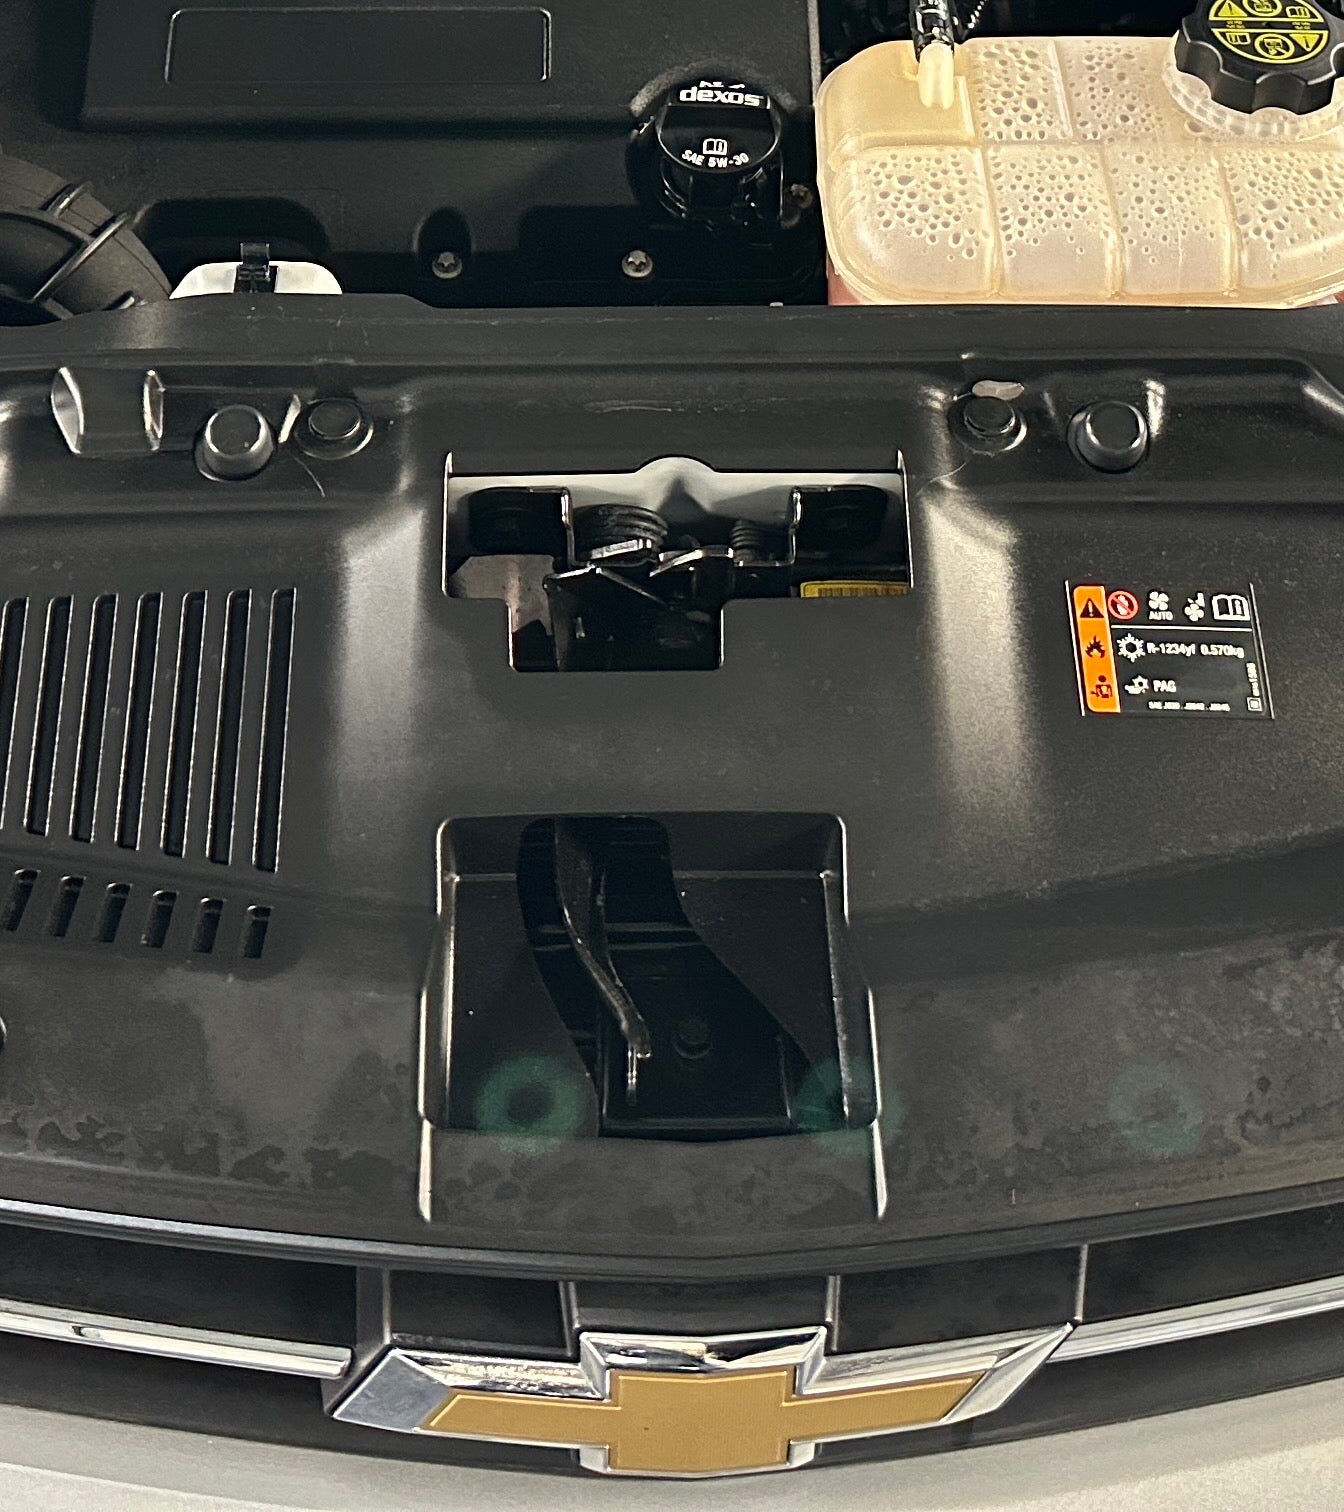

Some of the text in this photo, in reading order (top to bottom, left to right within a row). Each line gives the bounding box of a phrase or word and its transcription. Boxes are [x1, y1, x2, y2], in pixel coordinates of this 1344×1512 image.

[679, 86, 761, 107] dexos
[681, 149, 750, 168] SAE 5W-30
[1148, 611, 1174, 621] AUTO
[1200, 643, 1245, 659] 0.570kg
[1153, 679, 1177, 693] PAG
